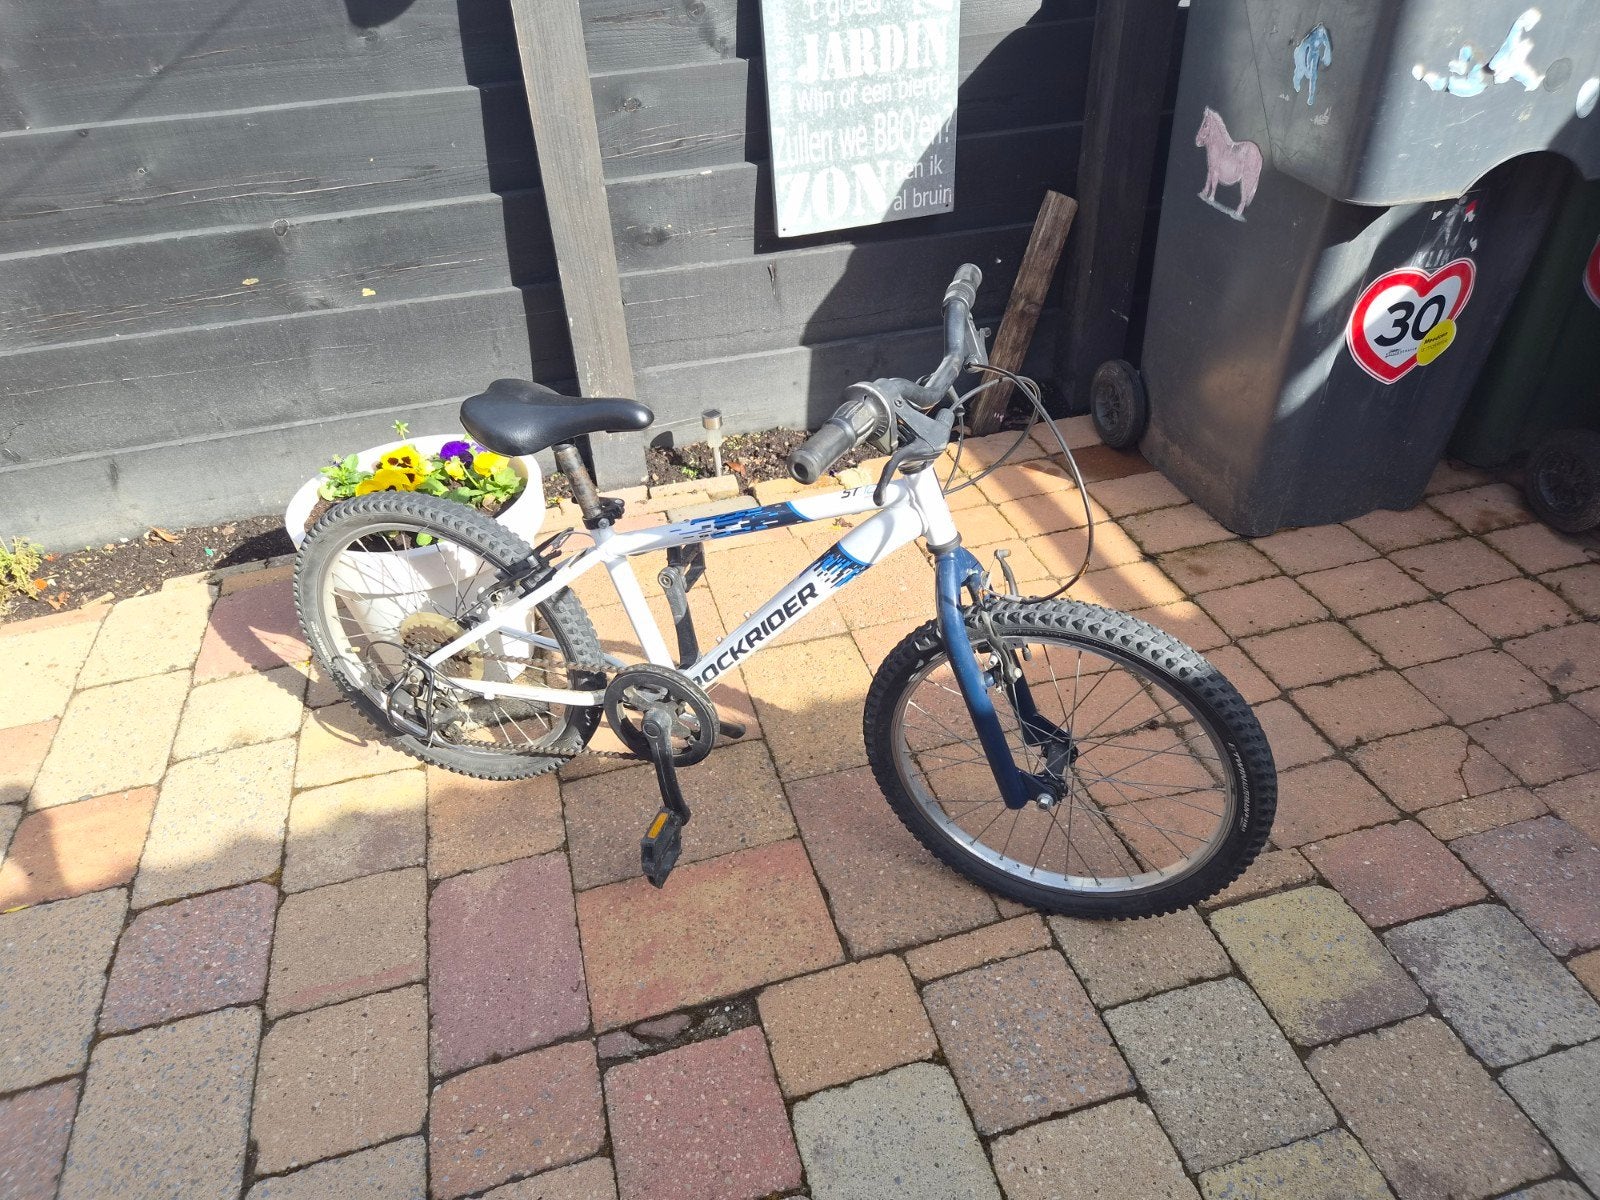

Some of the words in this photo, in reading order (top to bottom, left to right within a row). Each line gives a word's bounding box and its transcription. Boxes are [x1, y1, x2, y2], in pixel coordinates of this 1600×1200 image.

[796, 16, 949, 83] JARDIN
[796, 87, 835, 117] wijn
[840, 81, 857, 110] of
[862, 82, 893, 105] een
[772, 122, 834, 169] Zullen
[838, 123, 867, 161] we
[930, 154, 943, 176] ik
[777, 160, 891, 224] ZON
[894, 189, 907, 211] al
[913, 185, 952, 208] bruin
[1374, 295, 1446, 346] 30
